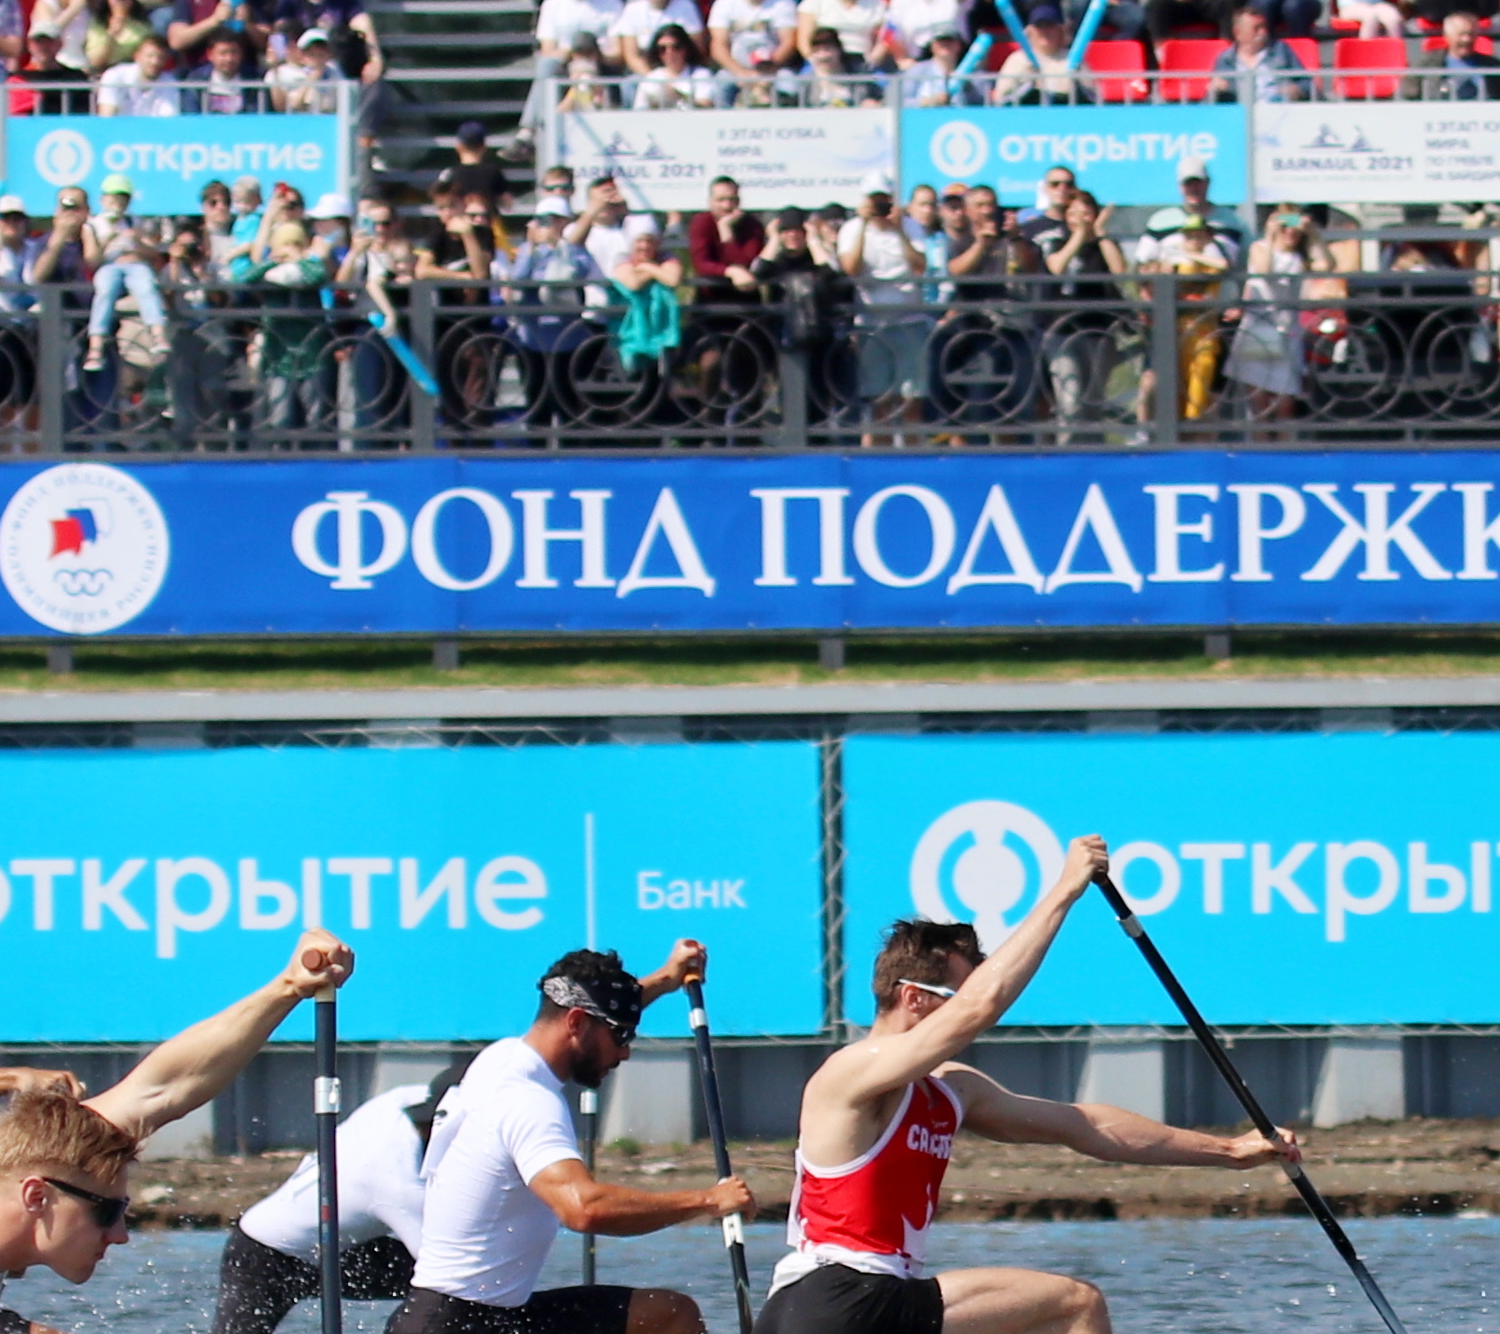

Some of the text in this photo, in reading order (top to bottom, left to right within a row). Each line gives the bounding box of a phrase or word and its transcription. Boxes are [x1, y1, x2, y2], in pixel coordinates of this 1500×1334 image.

[102, 142, 323, 181] открытие
[998, 132, 1218, 170] открытие
[1272, 156, 1414, 171] BARNAUL 2021
[660, 165, 706, 177] 2021
[294, 486, 714, 597] ФОНД
[637, 871, 746, 912] Банк
